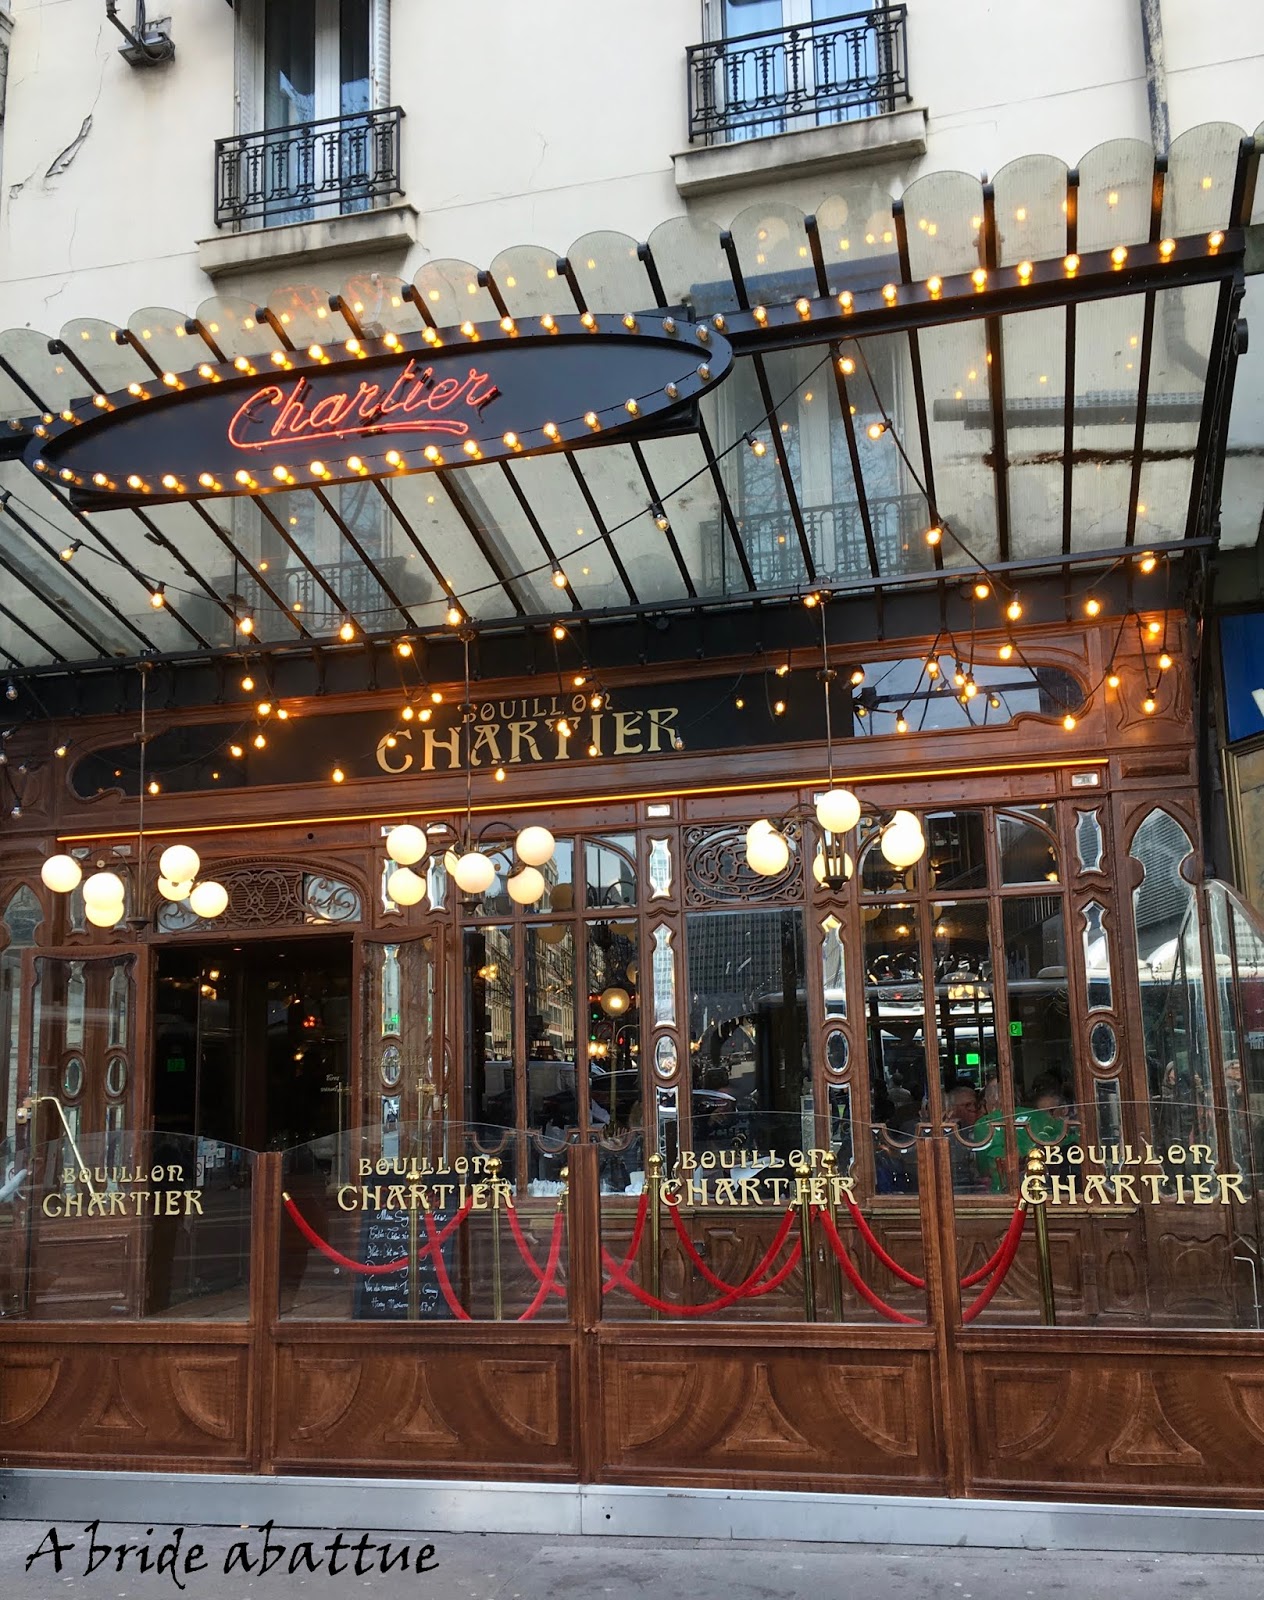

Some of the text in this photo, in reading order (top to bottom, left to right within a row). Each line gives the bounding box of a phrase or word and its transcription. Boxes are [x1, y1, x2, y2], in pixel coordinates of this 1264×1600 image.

[228, 358, 498, 449] Chartier
[375, 707, 684, 774] CHARTIER
[358, 1156, 490, 1176] BOUILLON
[681, 1148, 829, 1170] BOUILLON
[1043, 1144, 1215, 1165] BOUILLON
[63, 1164, 185, 1184] BOUILLON
[337, 1184, 515, 1211] CHARTIER
[659, 1177, 859, 1206] CHARTIER
[1020, 1174, 1249, 1205] CHARTIER
[42, 1190, 204, 1218] CHARTIER
